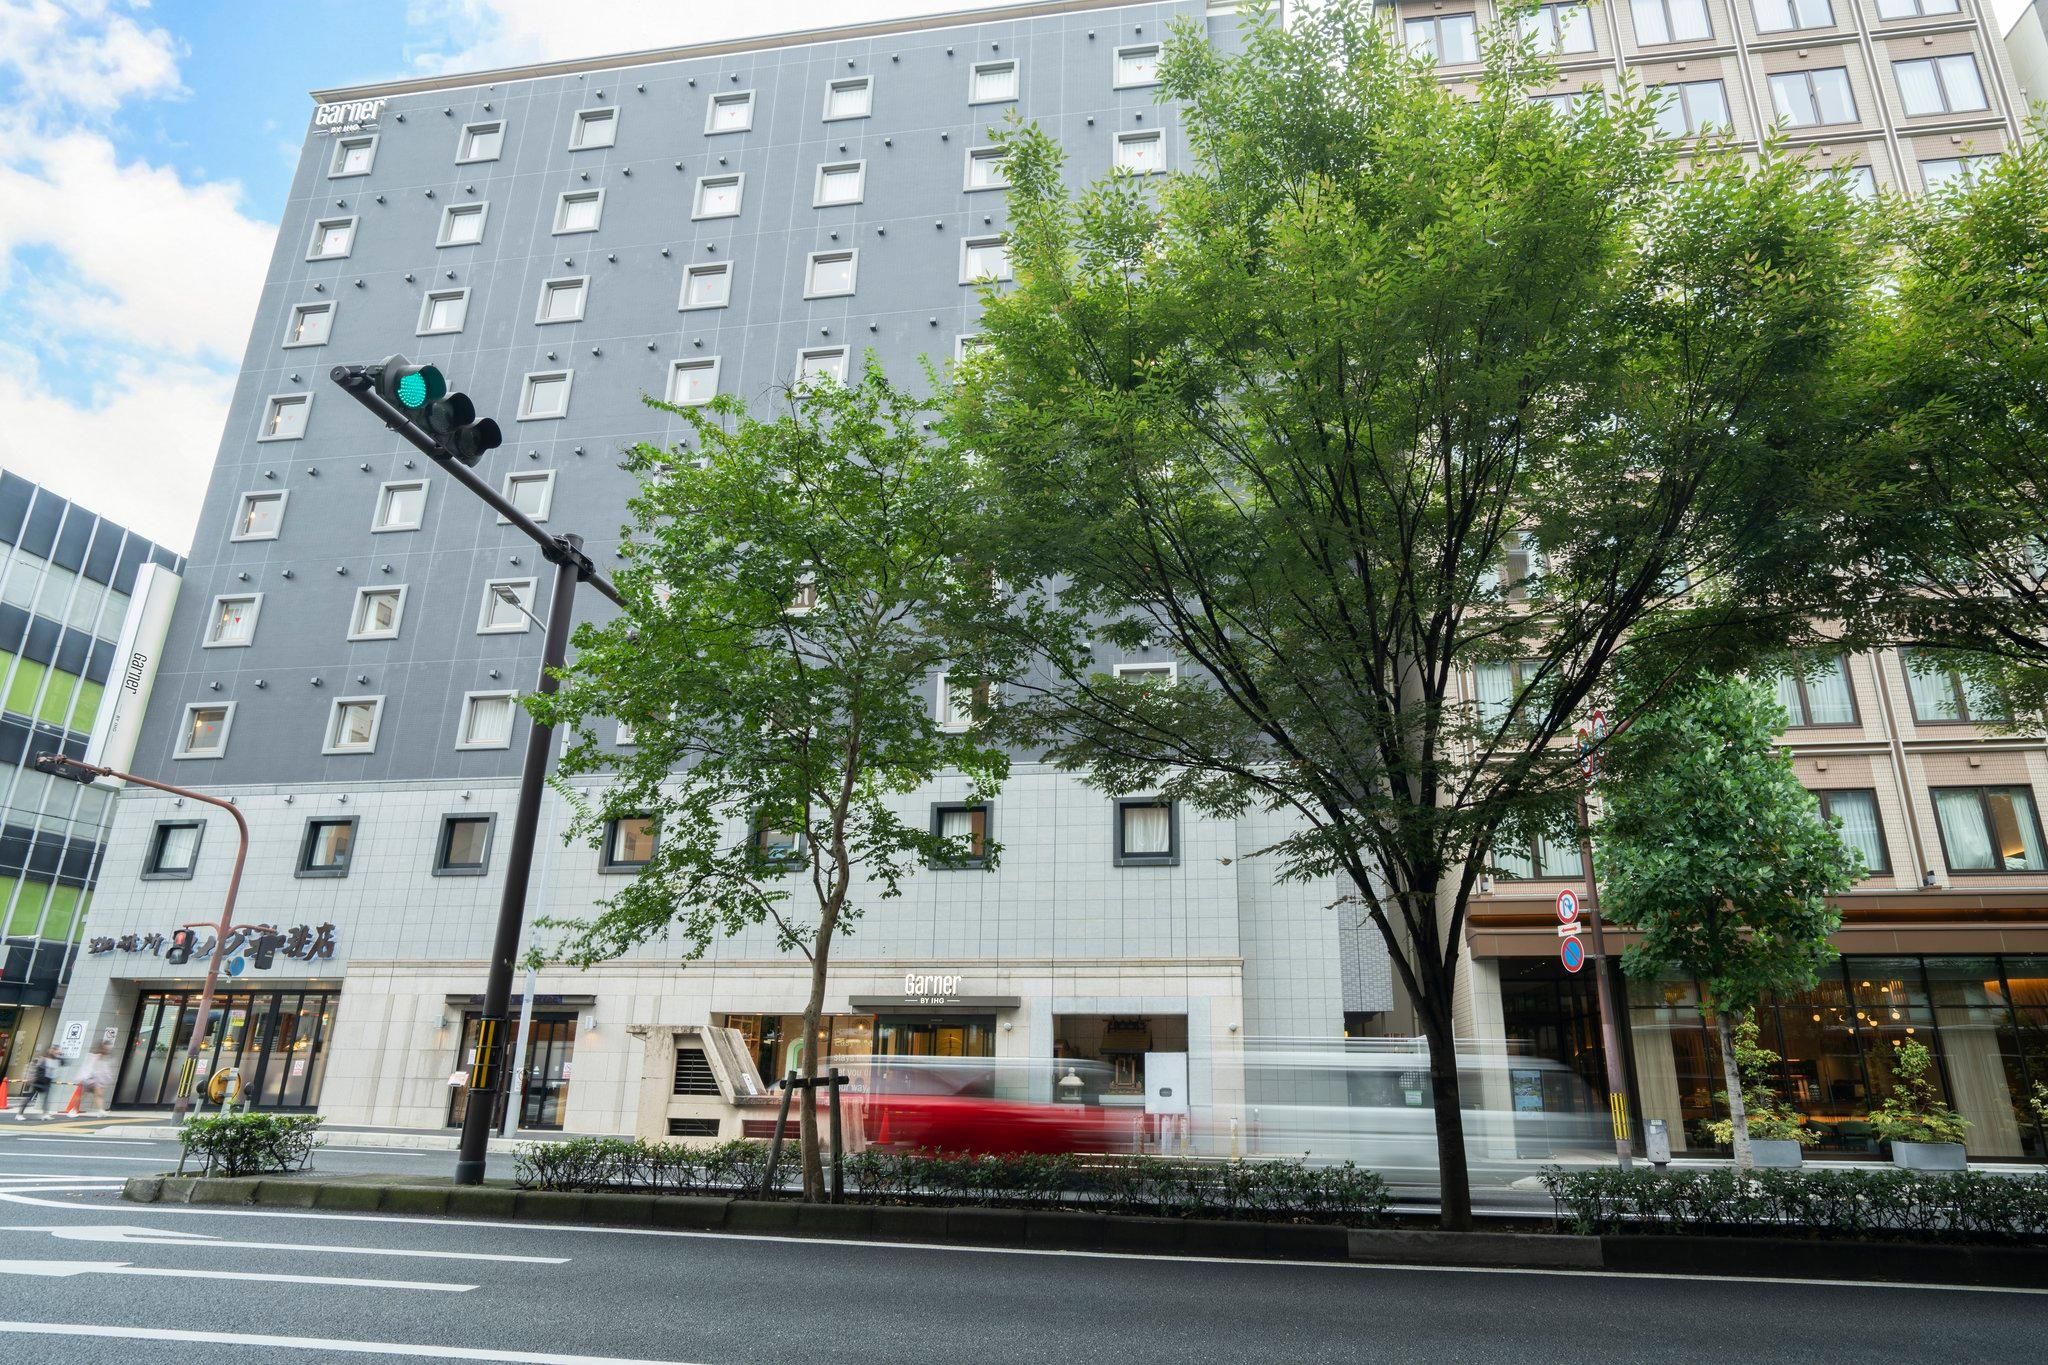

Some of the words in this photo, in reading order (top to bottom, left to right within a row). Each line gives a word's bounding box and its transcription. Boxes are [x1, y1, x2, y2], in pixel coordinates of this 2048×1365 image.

[315, 99, 385, 125] Garner
[125, 653, 147, 694] Garner
[905, 973, 961, 995] Garner
